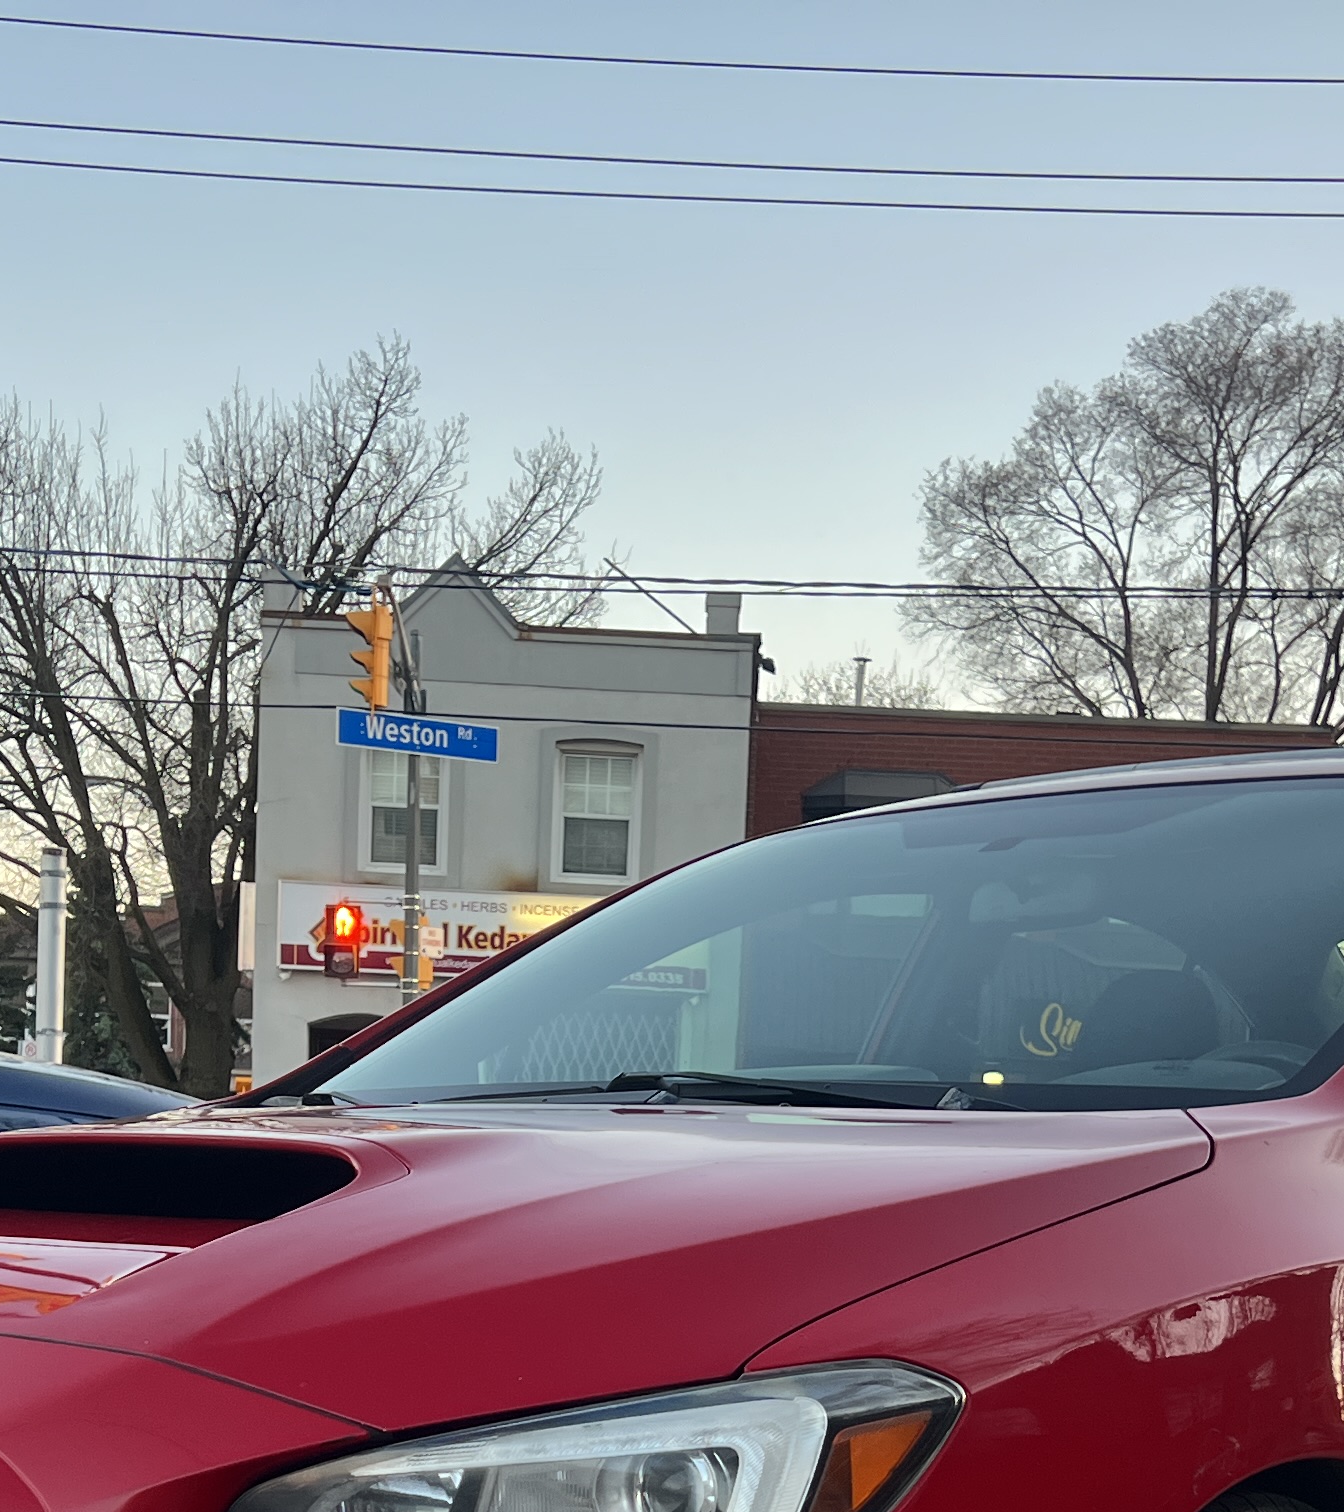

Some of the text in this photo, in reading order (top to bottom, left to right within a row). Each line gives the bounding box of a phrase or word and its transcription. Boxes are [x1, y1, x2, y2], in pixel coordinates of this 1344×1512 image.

[365, 714, 473, 749] Weston Rd
[460, 899, 508, 914] HERBS
[456, 922, 532, 951] Keda
